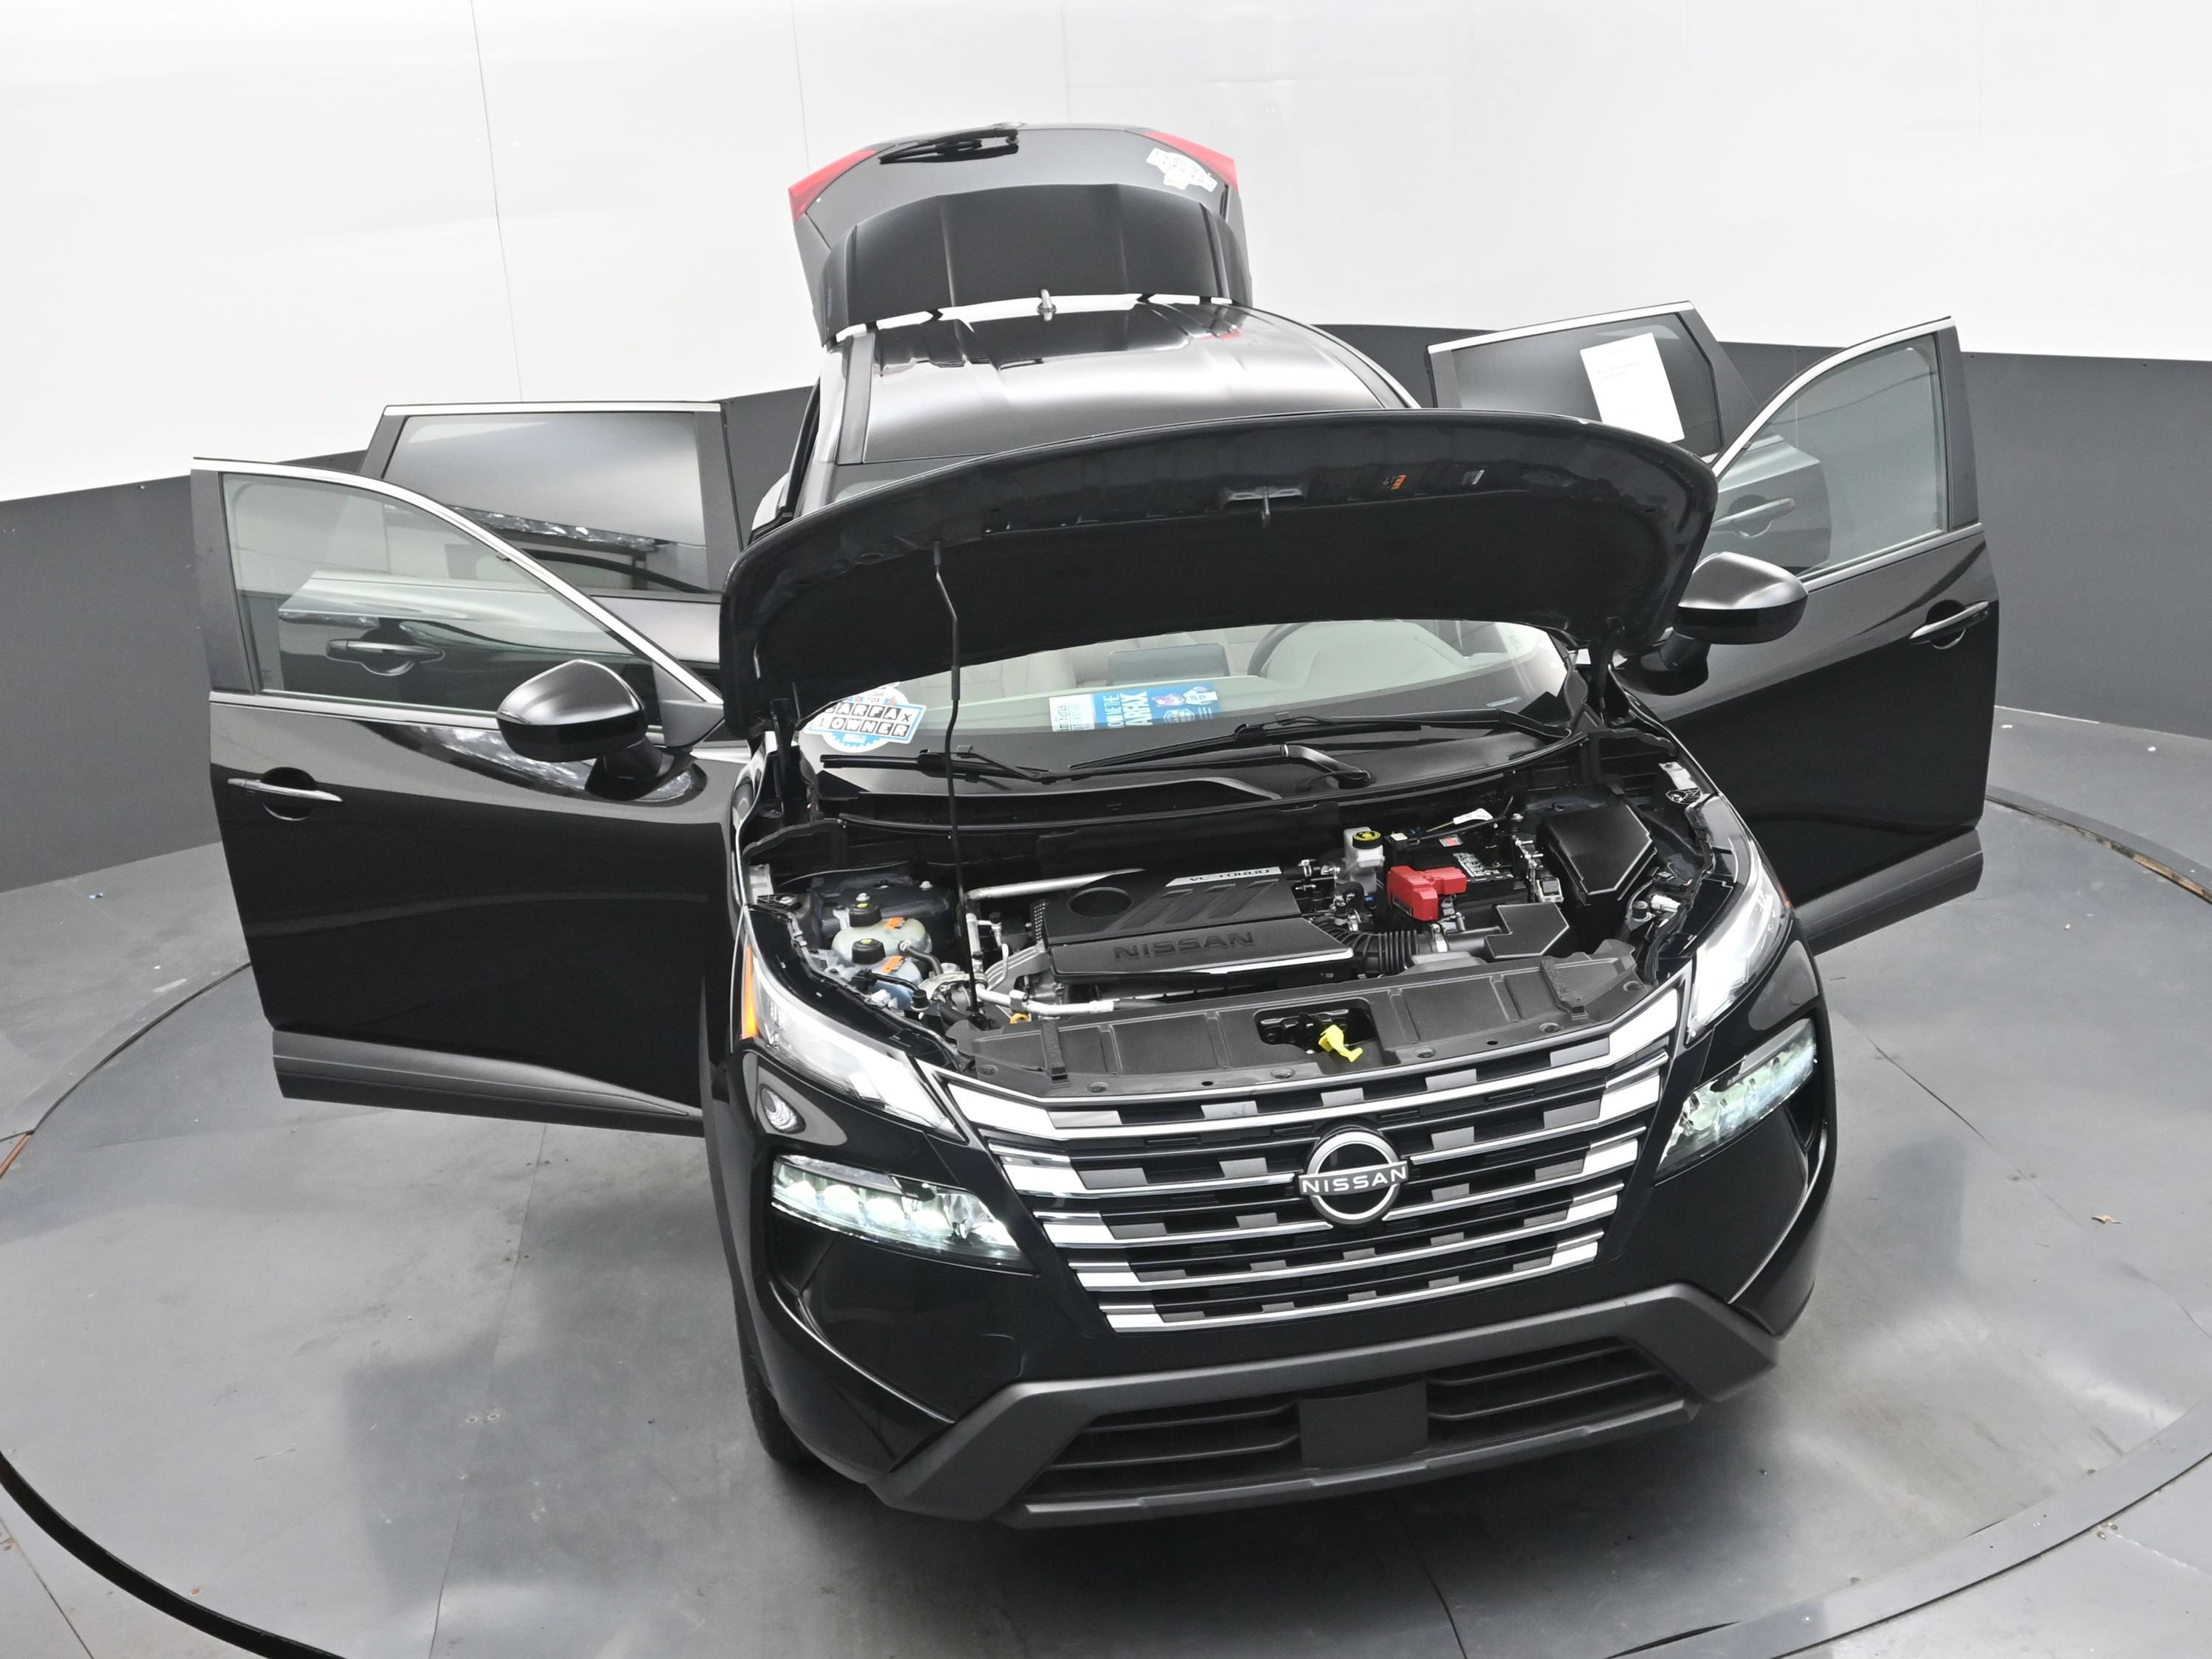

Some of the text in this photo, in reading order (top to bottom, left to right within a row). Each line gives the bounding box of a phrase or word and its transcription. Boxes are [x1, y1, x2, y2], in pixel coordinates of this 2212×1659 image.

[1120, 691, 1153, 726] ARFAX
[829, 717, 911, 737] OWNER
[1113, 931, 1255, 959] NISSAN
[1302, 1166, 1408, 1194] NISSAN
